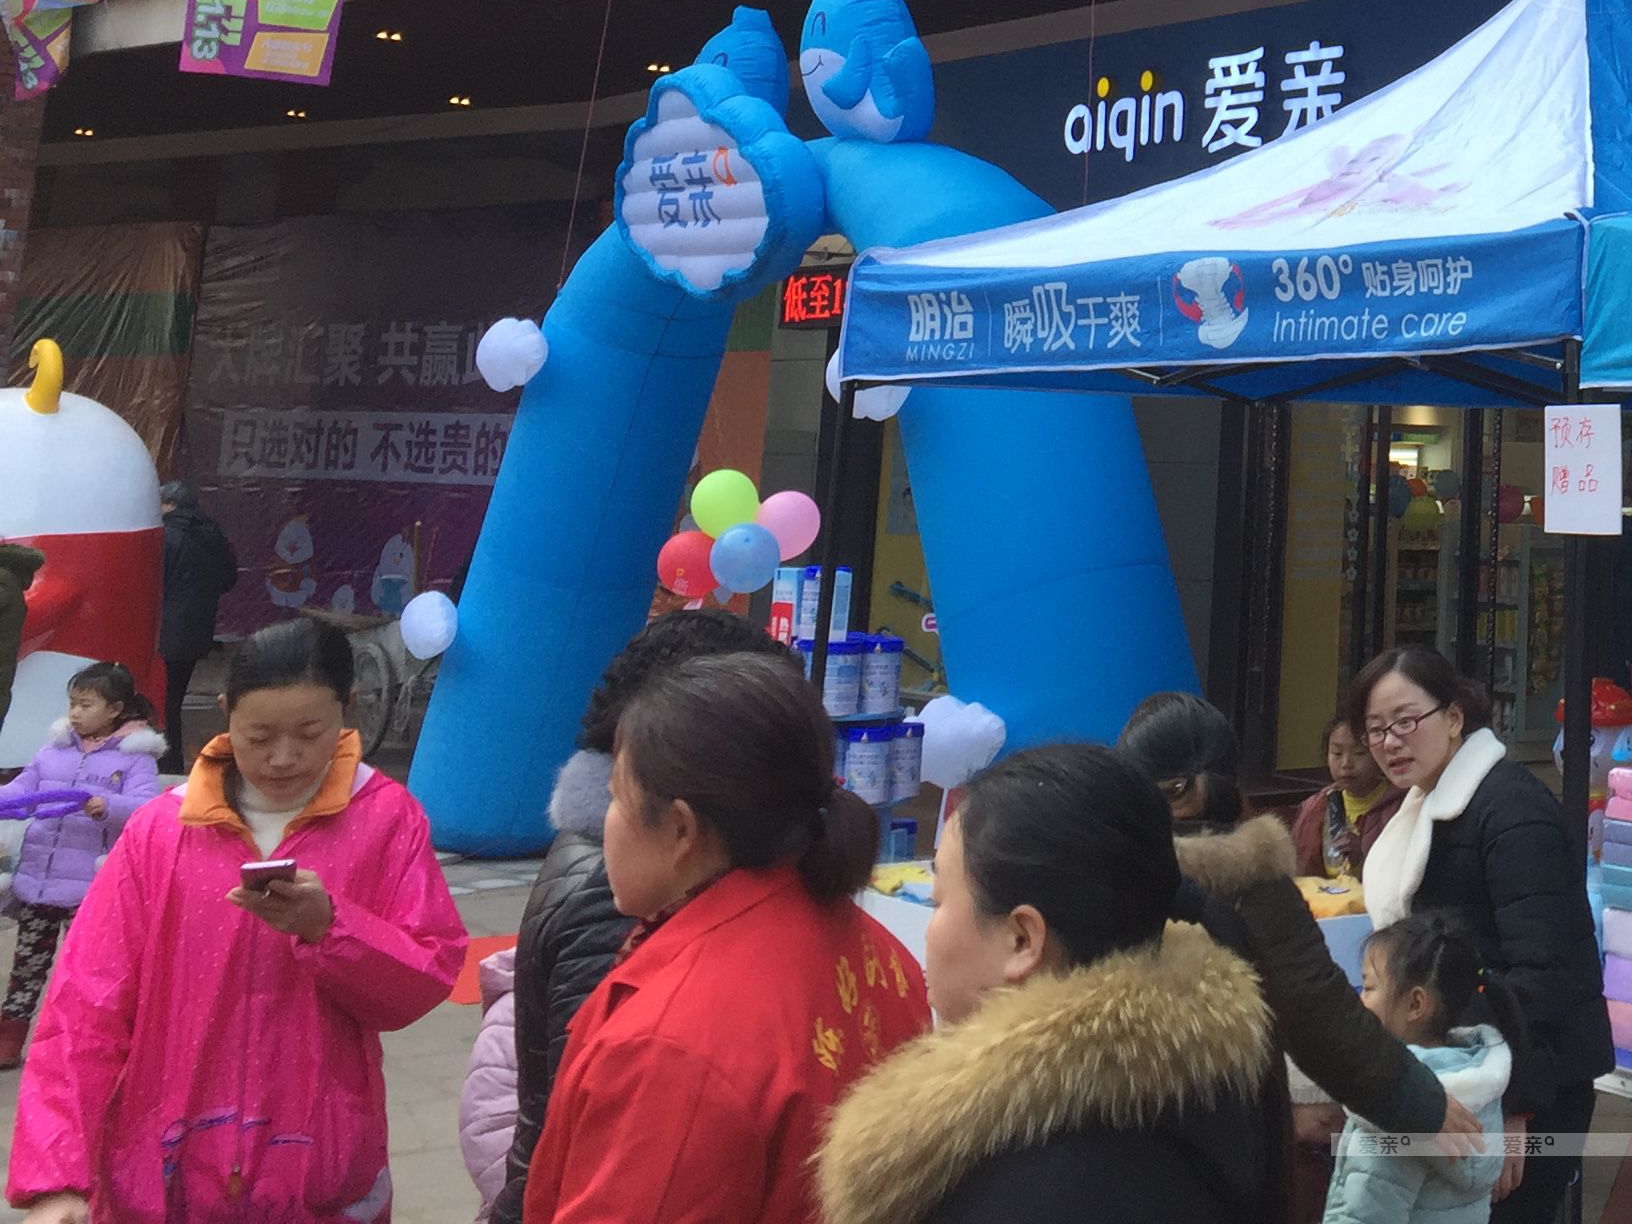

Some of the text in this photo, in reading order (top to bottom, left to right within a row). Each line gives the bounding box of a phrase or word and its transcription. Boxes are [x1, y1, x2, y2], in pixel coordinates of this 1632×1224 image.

[1064, 40, 1346, 163] aiqin 爱亲
[783, 273, 850, 324] 低至1
[907, 292, 975, 342] 明治
[1003, 280, 1143, 354] 瞬吸干爽
[1362, 256, 1474, 299] 贴身呵护
[1272, 307, 1467, 344] Intimate care
[905, 344, 975, 362] MINGZI
[226, 418, 510, 476] 只选对的 不选贵的
[1550, 416, 1596, 449] 预存
[1550, 463, 1599, 496] 赠品
